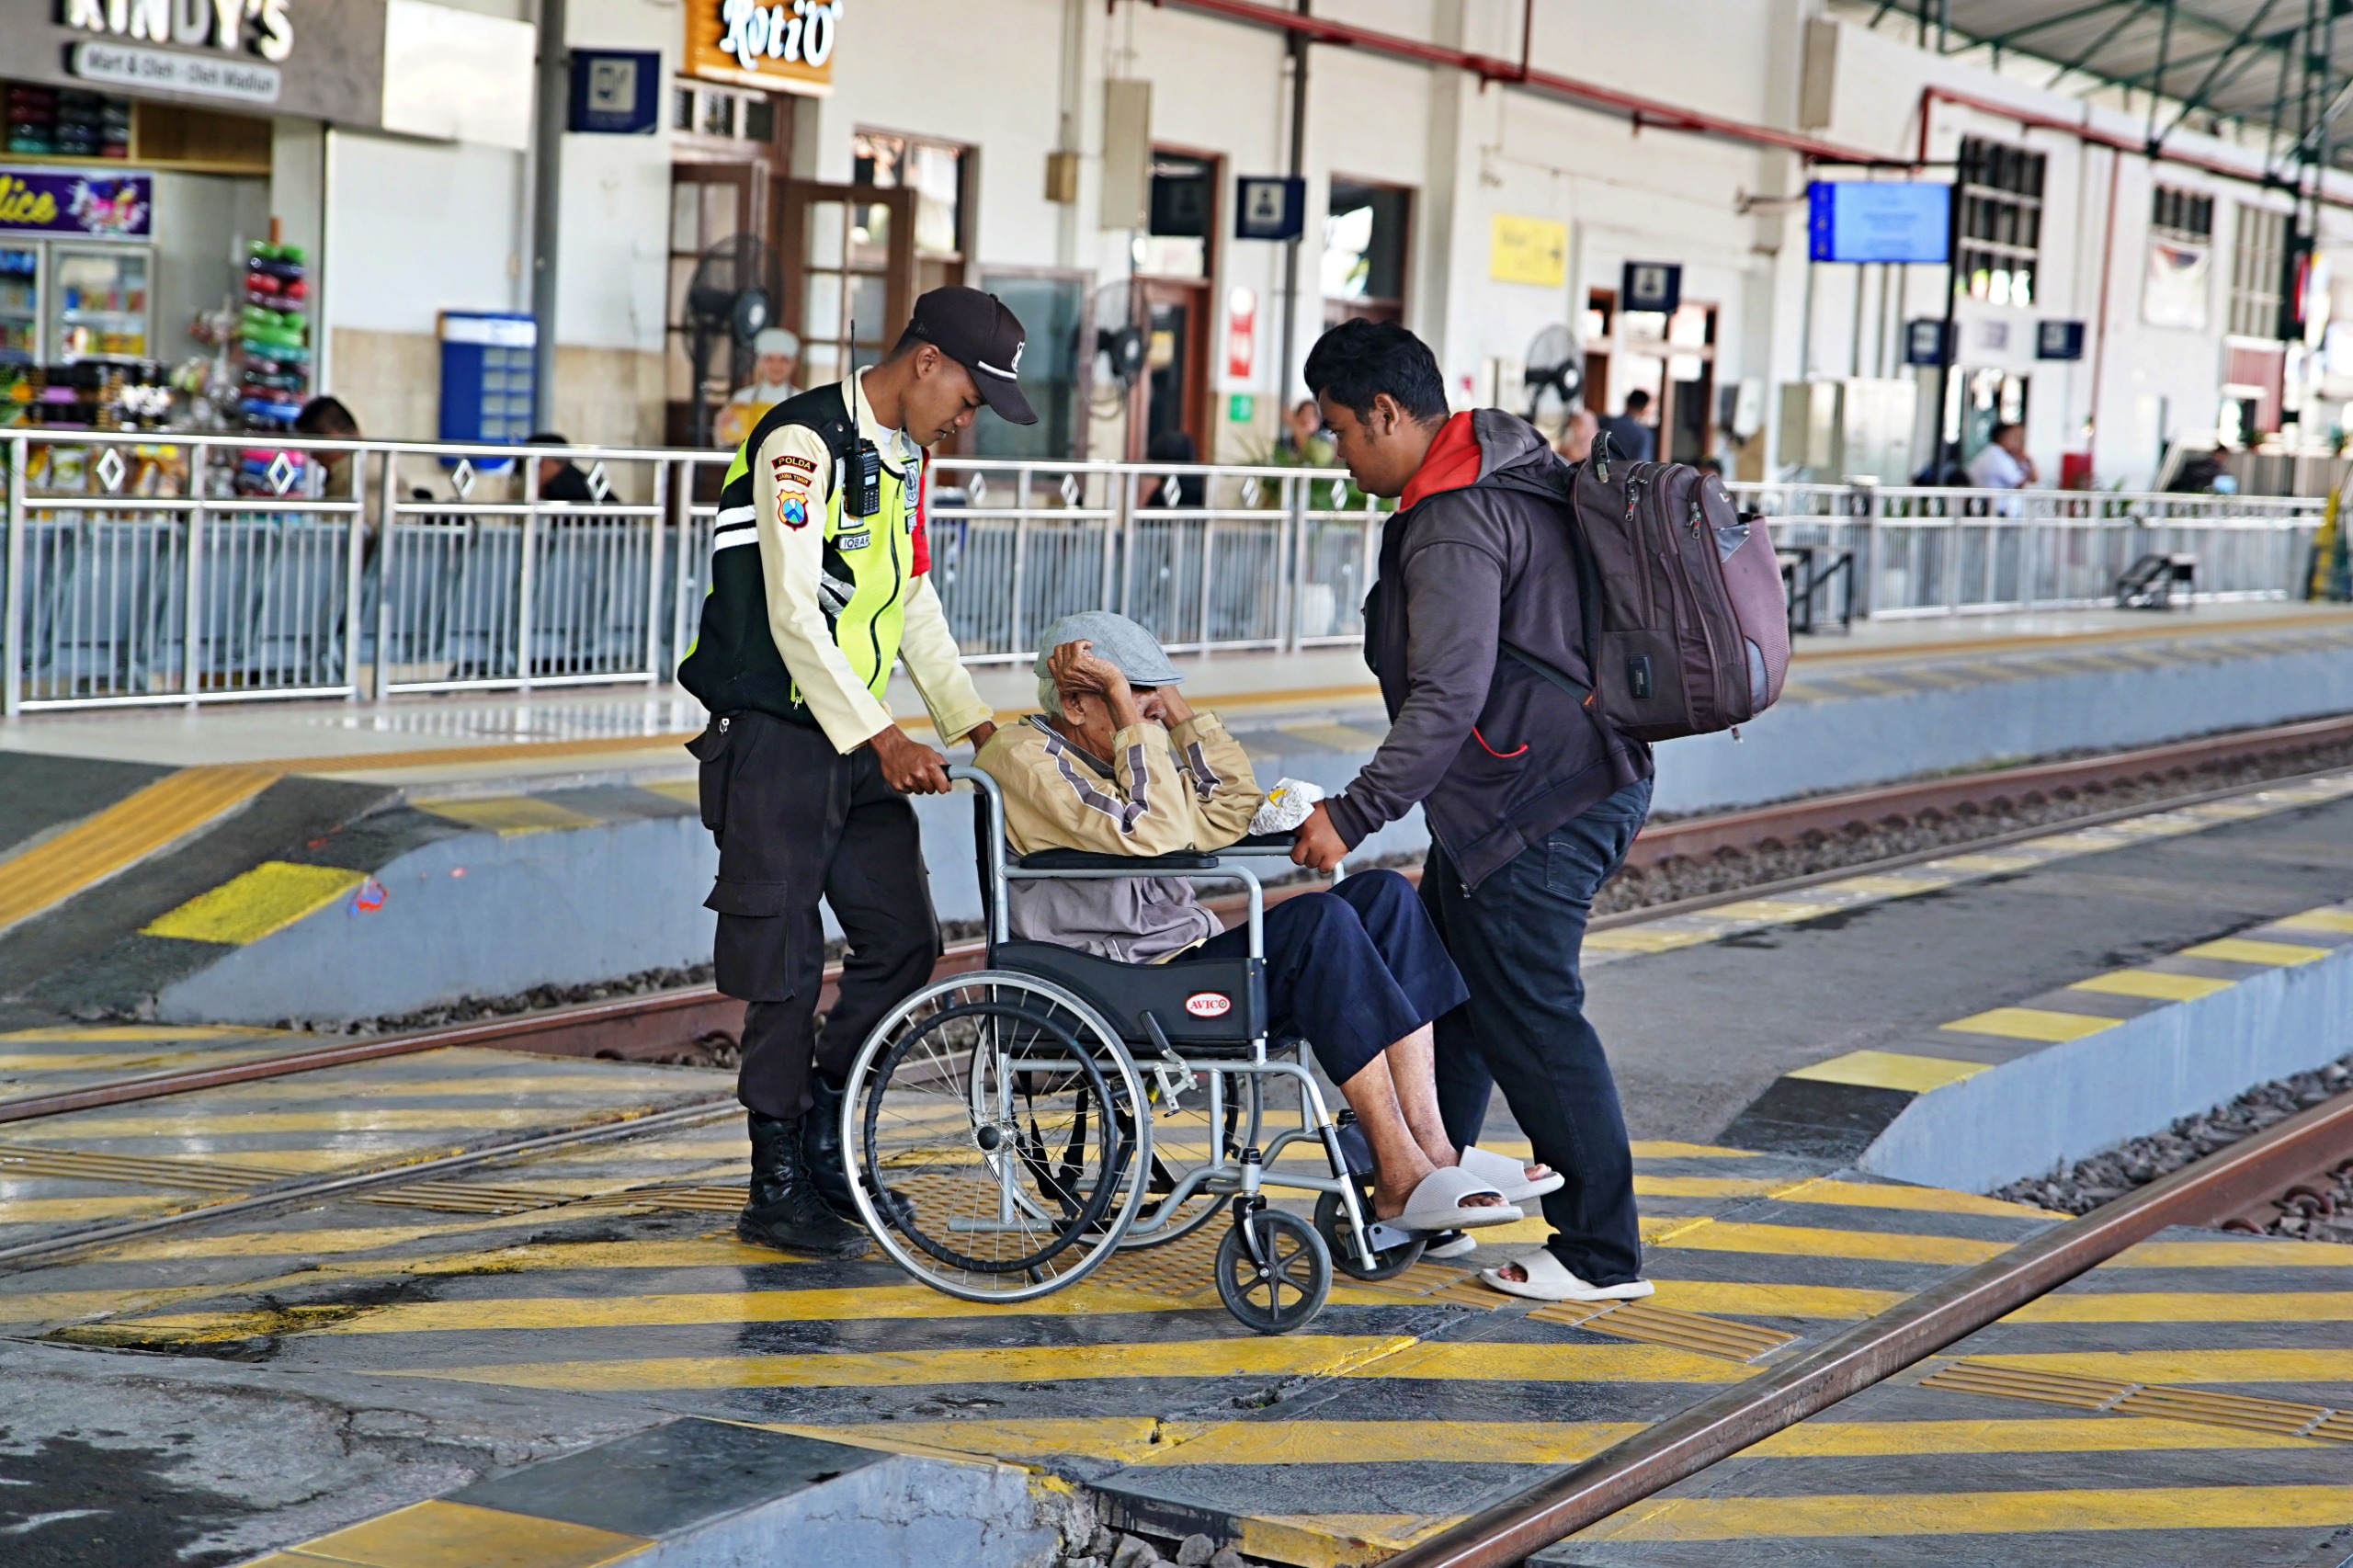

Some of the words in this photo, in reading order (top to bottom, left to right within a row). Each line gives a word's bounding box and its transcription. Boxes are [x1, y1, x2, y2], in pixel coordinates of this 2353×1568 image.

[128, 55, 137, 74] &
[779, 457, 811, 470] POLDA
[793, 474, 809, 485] TIMUR
[1190, 998, 1228, 1009] AVICO
